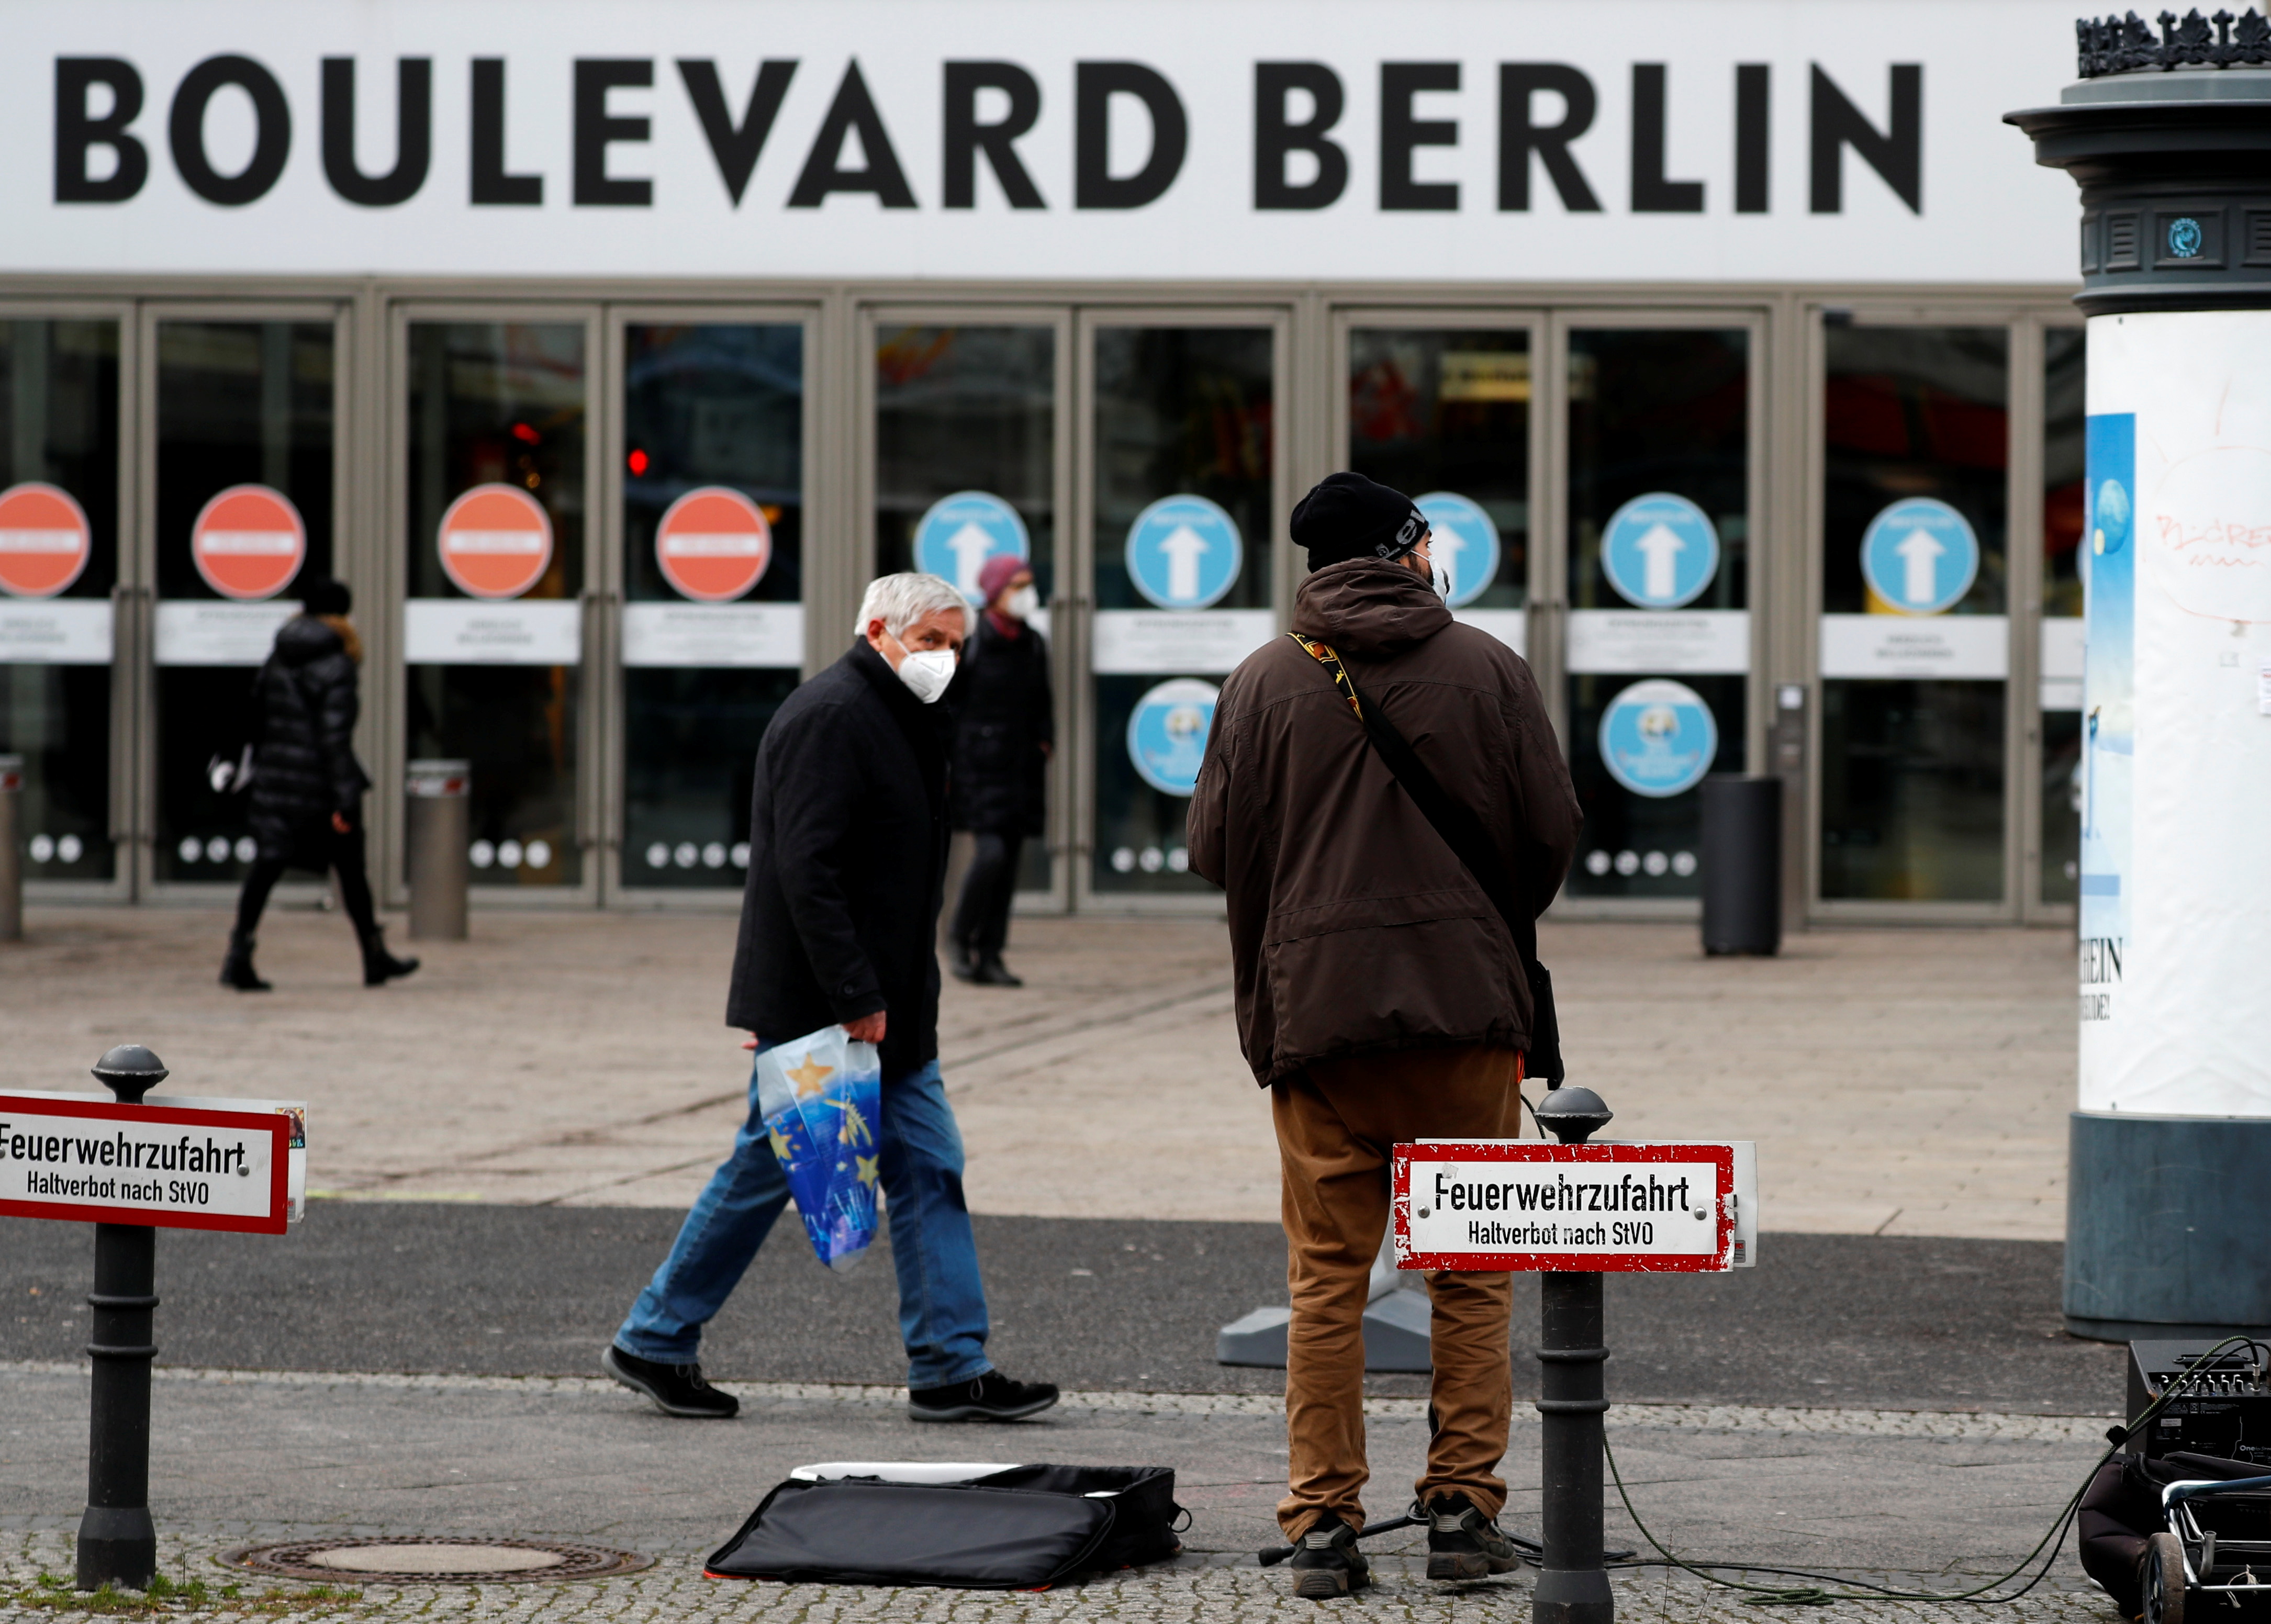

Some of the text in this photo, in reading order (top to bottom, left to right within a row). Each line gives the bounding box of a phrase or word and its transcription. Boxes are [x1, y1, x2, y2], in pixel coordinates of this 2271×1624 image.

[54, 52, 1923, 217] BOULEVARD BERLIN
[2079, 936, 2123, 984] HEIN
[27, 1170, 209, 1205] Haltverbot nach StVO
[1435, 1172, 1690, 1212] Feuerwehrzufahrt
[1468, 1220, 1653, 1246] Haltverbot nach StVO
